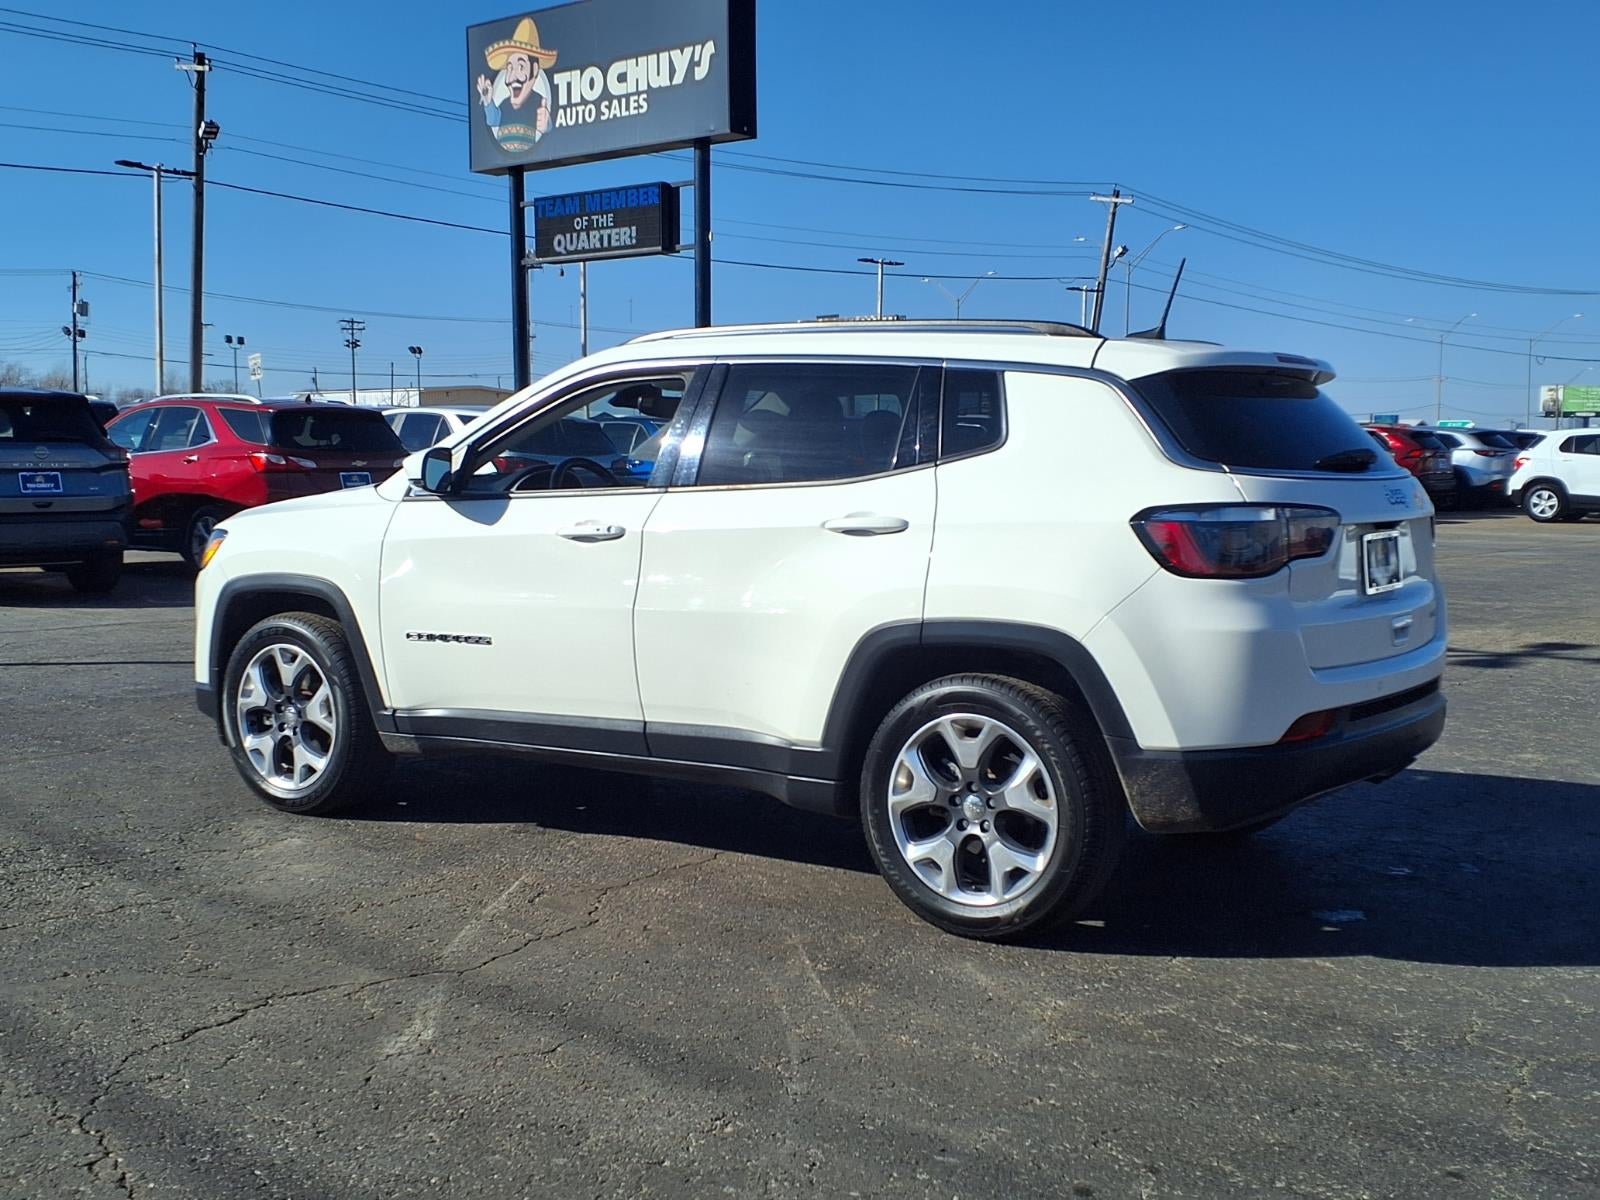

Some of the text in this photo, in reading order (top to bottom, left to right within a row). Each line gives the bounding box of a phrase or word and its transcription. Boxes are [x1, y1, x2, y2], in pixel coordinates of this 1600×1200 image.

[553, 40, 716, 106] TIO CHUY'S
[555, 93, 648, 128] AUTO SALES
[535, 186, 660, 218] TEAM MEMBER
[573, 213, 615, 230] OF THE
[553, 225, 637, 254] QUARTER!
